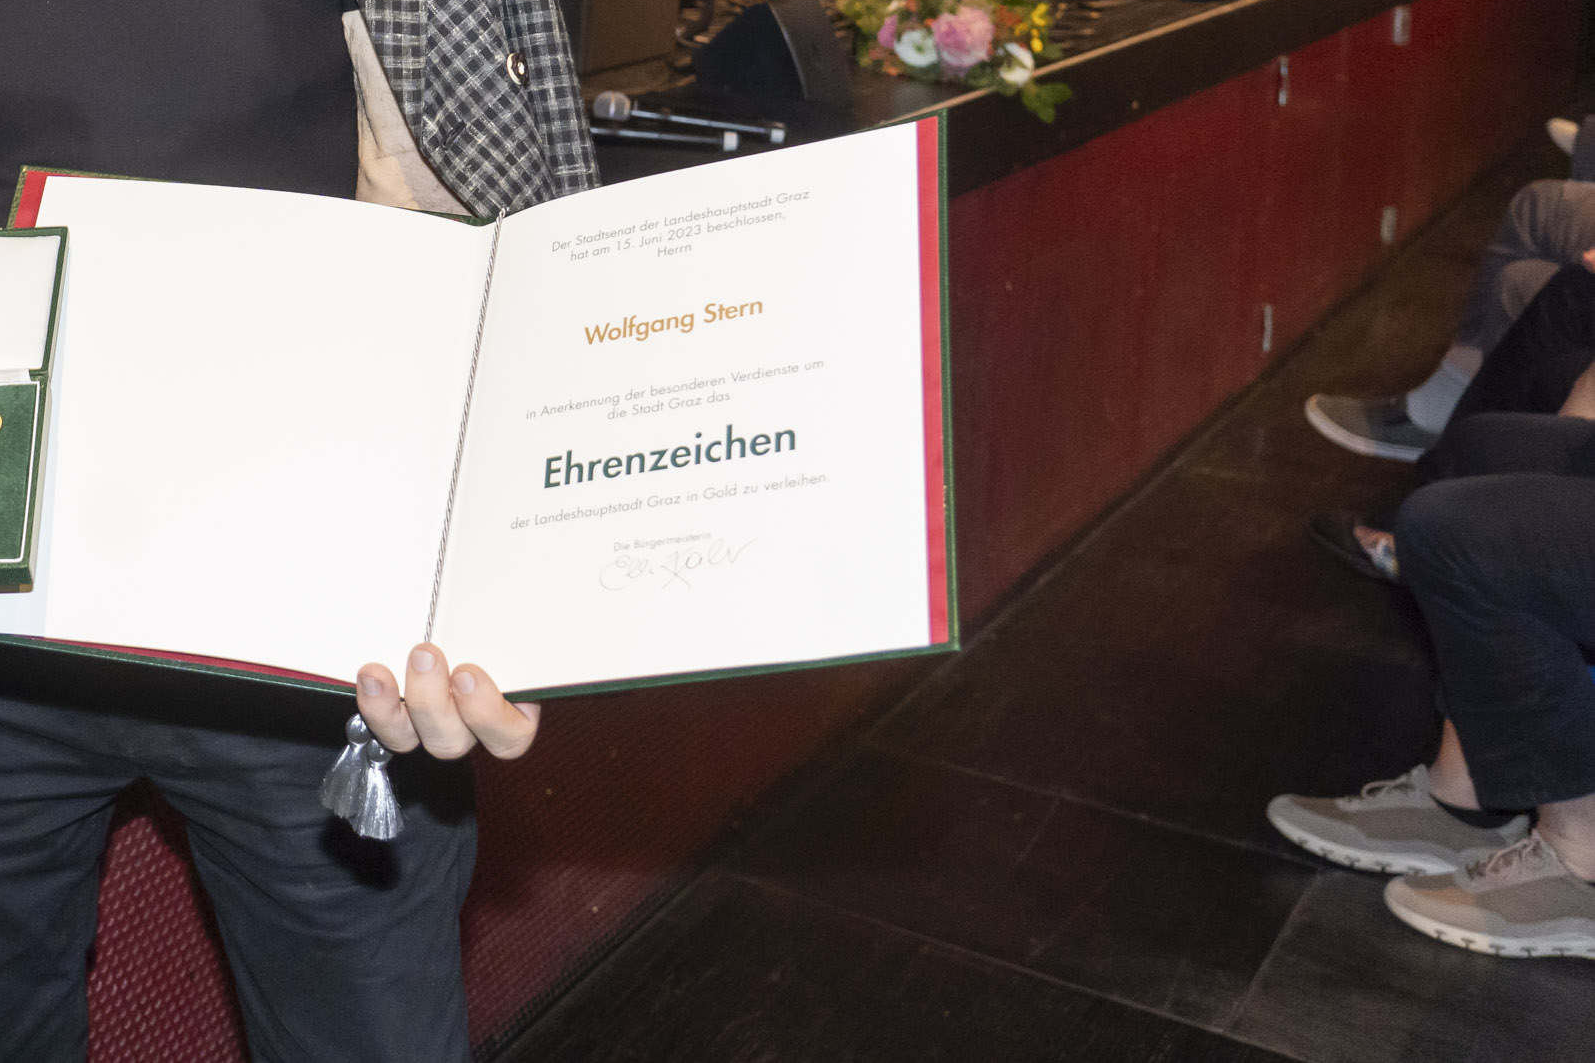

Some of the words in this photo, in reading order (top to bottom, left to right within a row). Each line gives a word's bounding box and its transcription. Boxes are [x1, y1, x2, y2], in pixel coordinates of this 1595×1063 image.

[551, 240, 572, 253] Der
[574, 224, 637, 247] Stadtsenat
[639, 219, 660, 232] der
[663, 194, 774, 228] Landeshauptstadt
[775, 191, 810, 204] Graz
[570, 248, 589, 262] hat
[591, 246, 611, 257] am
[616, 237, 636, 252] 15.
[638, 232, 663, 249] Juni
[667, 224, 702, 241] 2023
[705, 210, 788, 234] beschlossen,
[657, 244, 692, 258] Herrn
[585, 314, 694, 345] Wolfgang
[704, 301, 762, 323] Stern
[525, 409, 537, 420] in
[539, 393, 621, 417] Anerkennung
[624, 388, 646, 401] der
[649, 377, 726, 397] besonderen
[730, 364, 800, 383] Verdienste
[804, 360, 824, 371] um
[606, 406, 628, 420] die
[631, 399, 665, 416] Stadt
[668, 397, 702, 410] Graz
[706, 391, 731, 404] das
[544, 424, 797, 489] Ehrenzeichen
[510, 516, 531, 530] der
[534, 497, 643, 526] Landeshauptstadt
[645, 494, 682, 508] Graz
[685, 489, 700, 503] in
[702, 483, 738, 500] Gold
[742, 485, 759, 495] zu
[613, 541, 631, 552] Die
